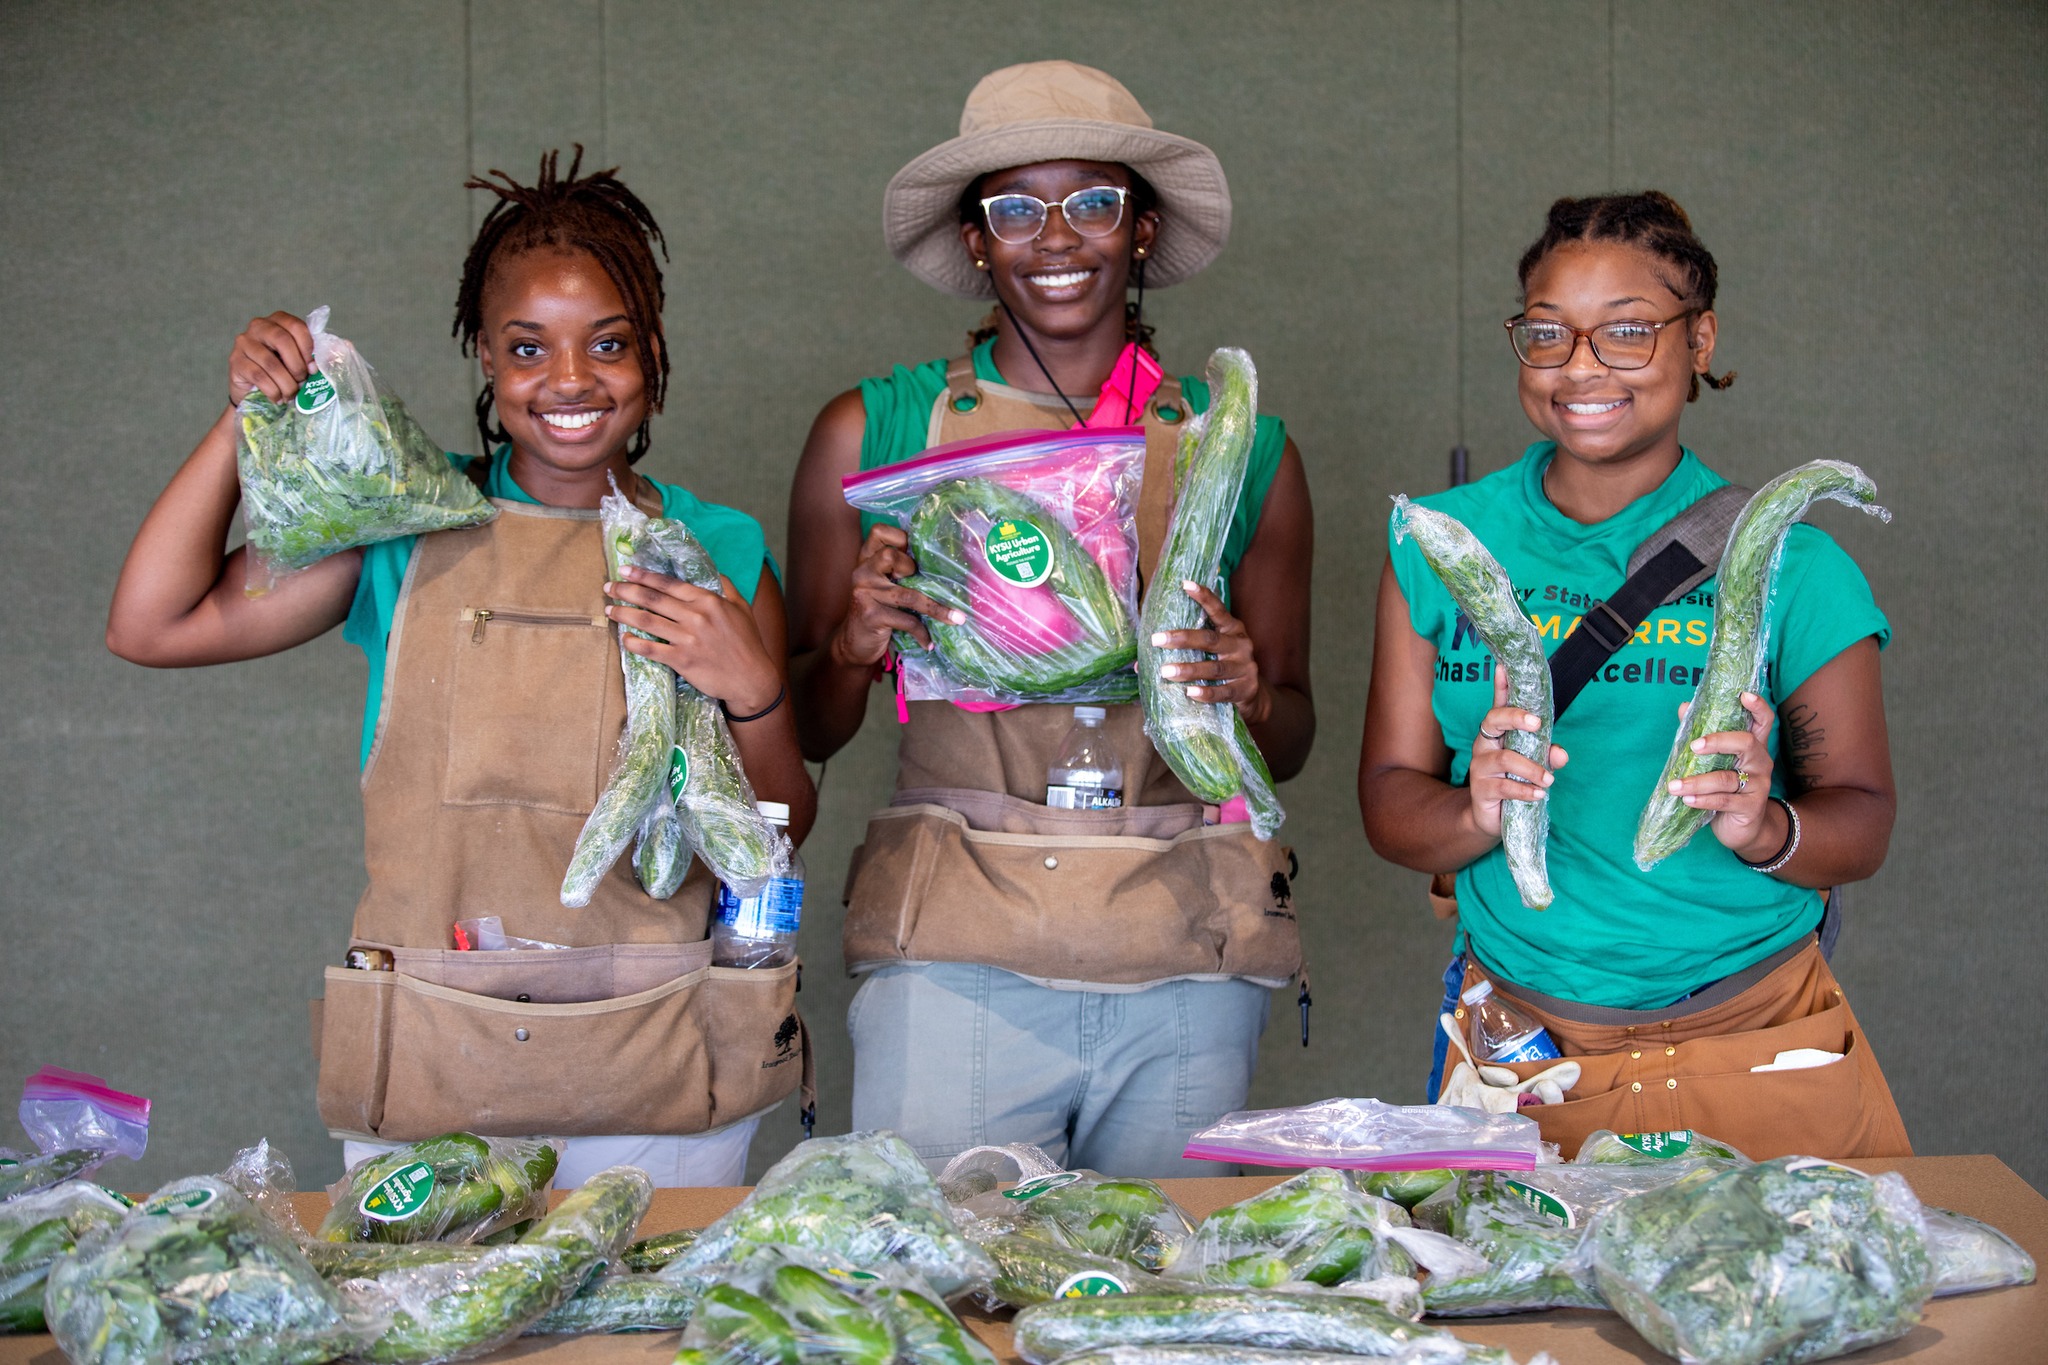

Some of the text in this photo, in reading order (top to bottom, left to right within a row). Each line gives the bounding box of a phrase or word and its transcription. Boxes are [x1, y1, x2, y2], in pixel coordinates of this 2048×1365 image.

[989, 541, 1012, 554] KYSU
[1011, 535, 1040, 548] Urban
[995, 545, 1041, 562] Agriculture
[1531, 613, 1707, 646] MARRS
